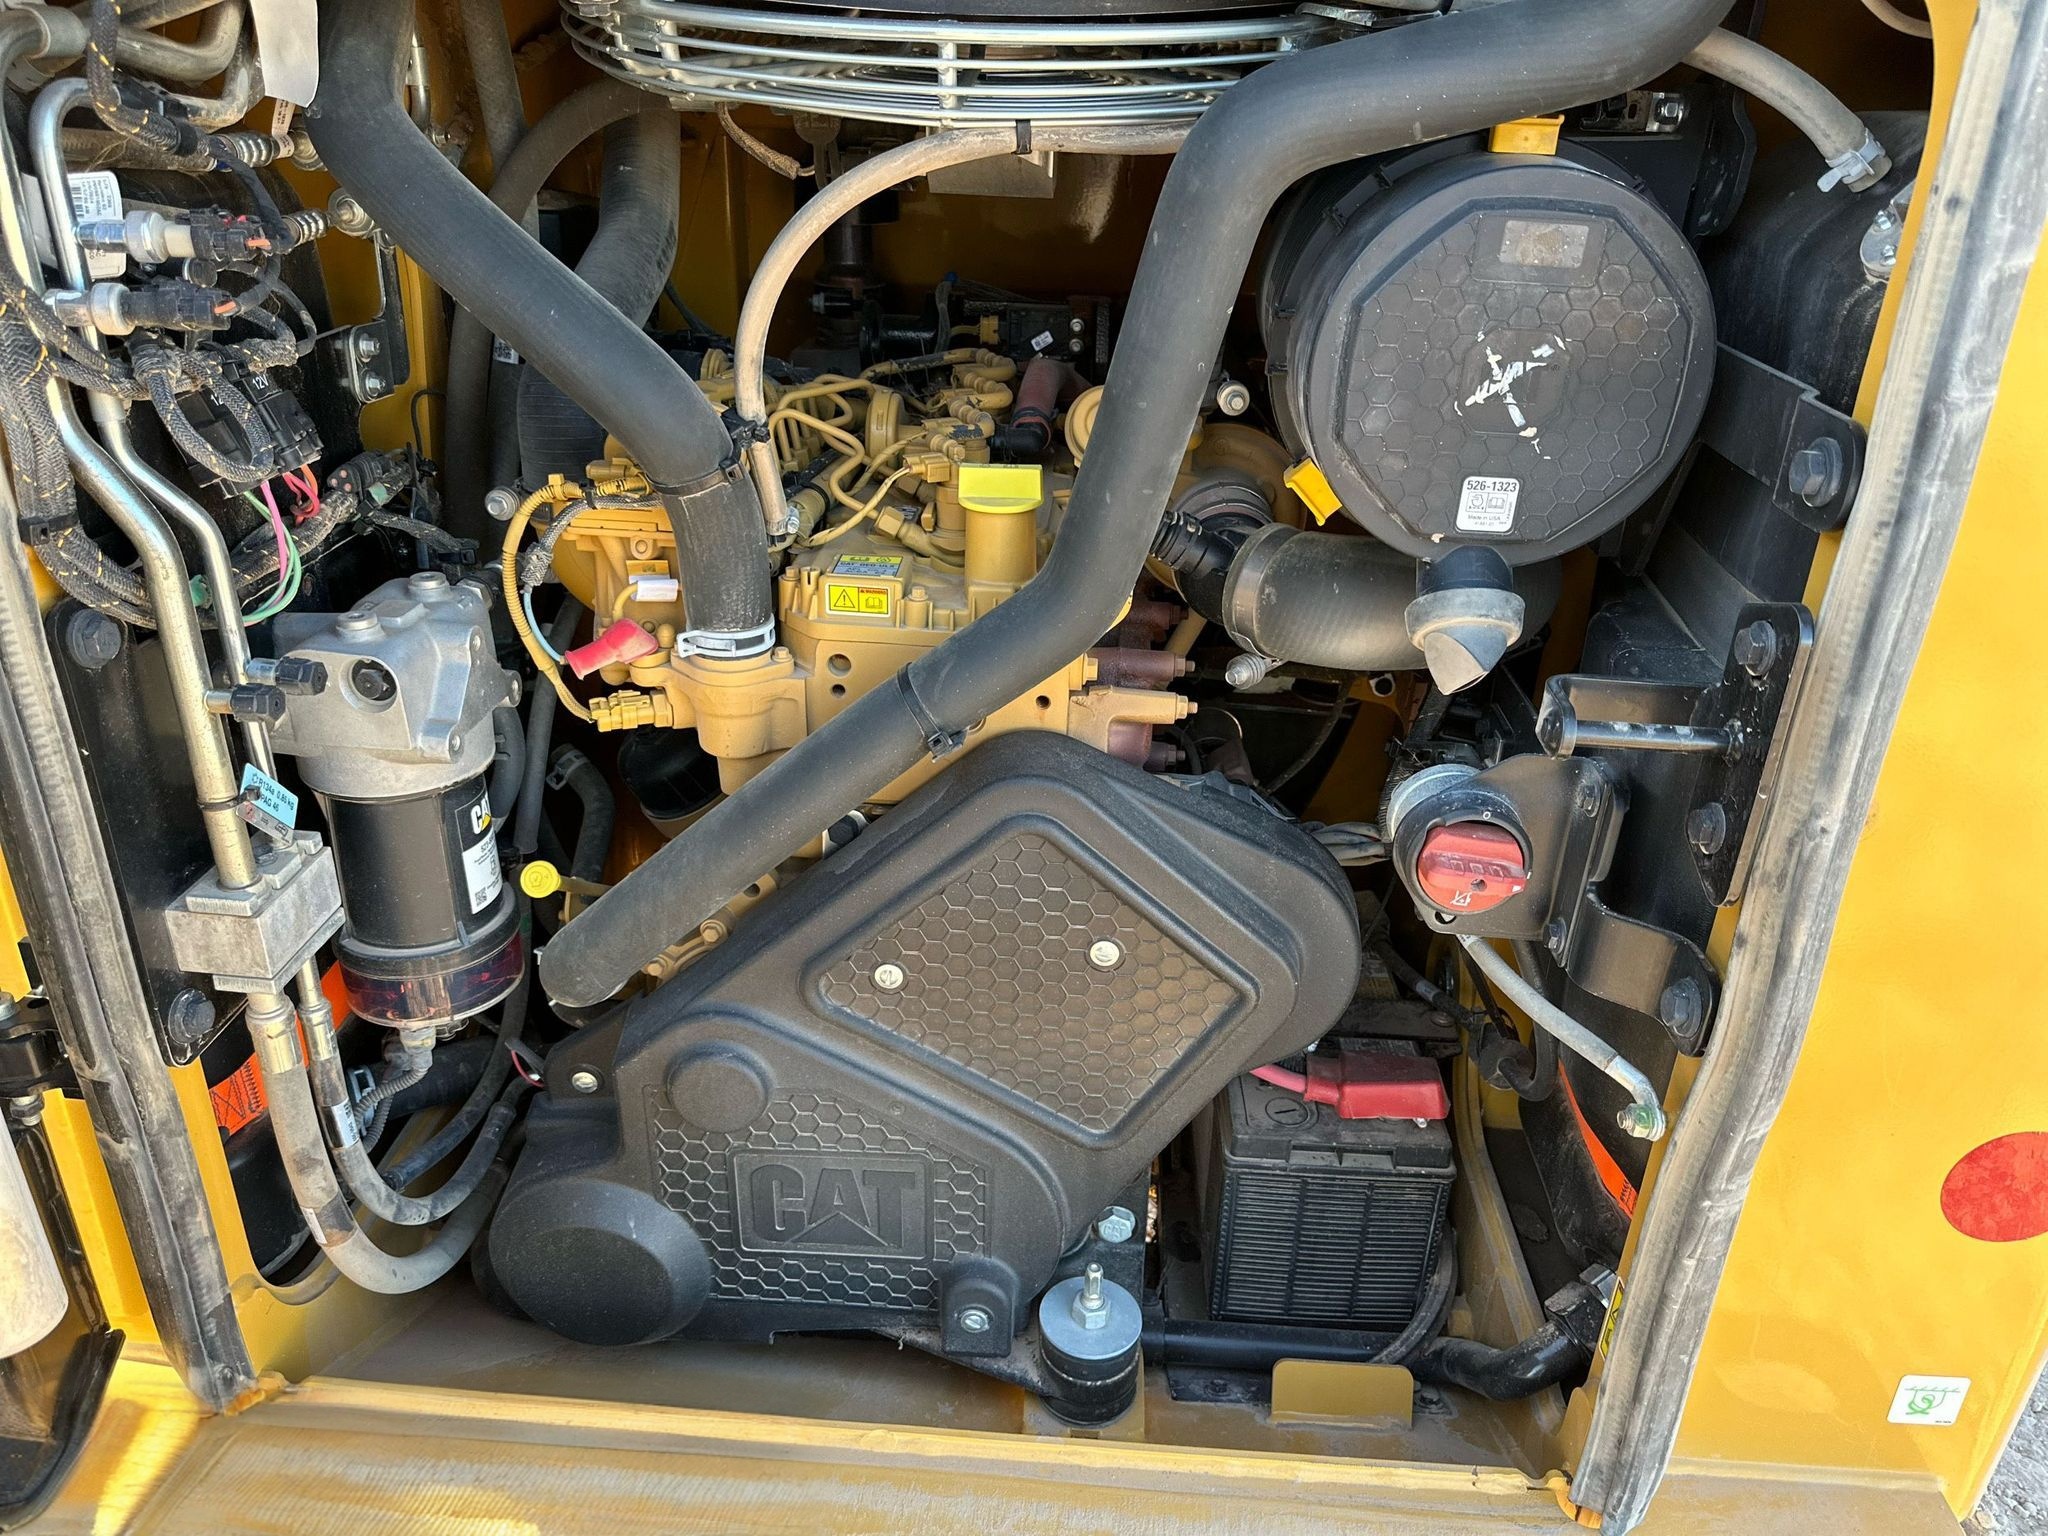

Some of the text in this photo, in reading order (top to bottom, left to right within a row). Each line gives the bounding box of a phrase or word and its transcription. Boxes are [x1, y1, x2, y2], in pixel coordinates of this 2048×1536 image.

[252, 374, 269, 390] 12V
[1466, 480, 1517, 492] 526-1323
[260, 794, 272, 807] PAG
[751, 1163, 916, 1249] CAT
